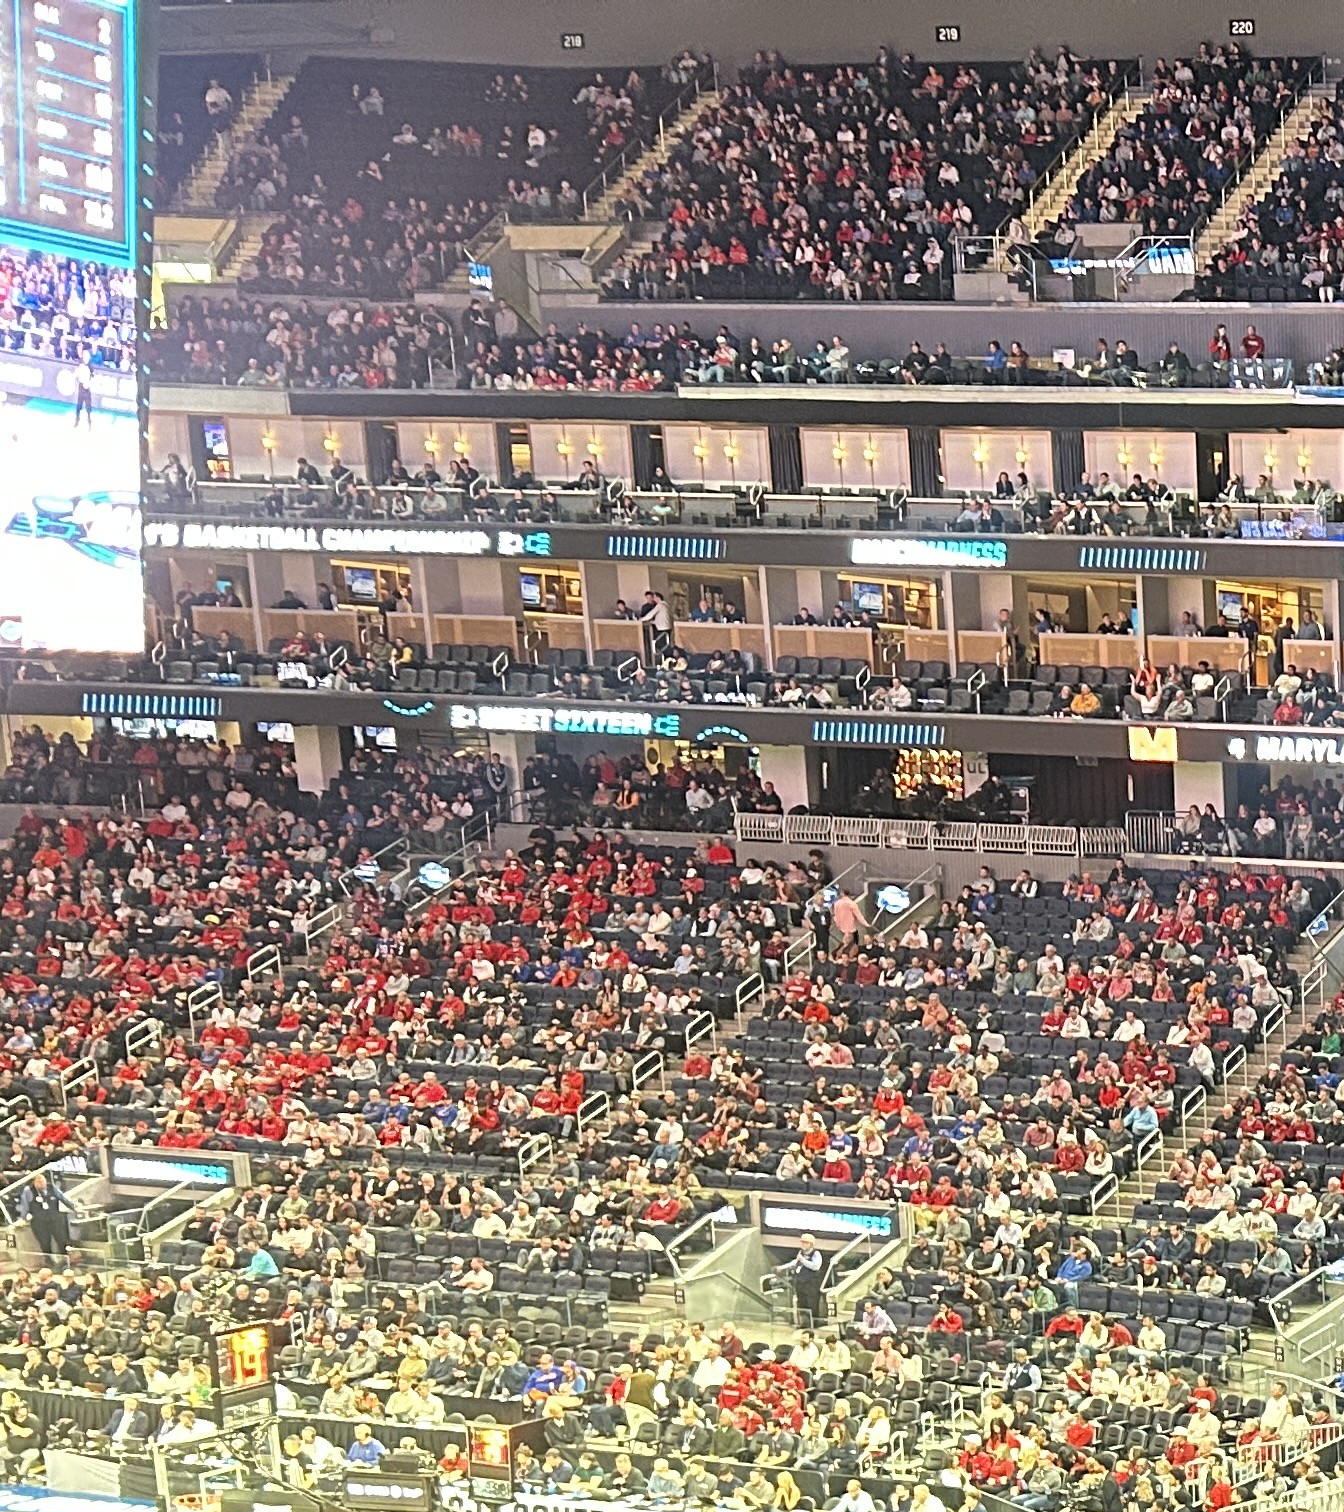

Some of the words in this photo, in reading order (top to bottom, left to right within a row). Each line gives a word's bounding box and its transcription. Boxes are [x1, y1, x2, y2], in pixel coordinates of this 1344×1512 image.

[939, 27, 958, 40] 219
[1231, 21, 1253, 34] 220
[554, 709, 652, 735] SIXTEEN
